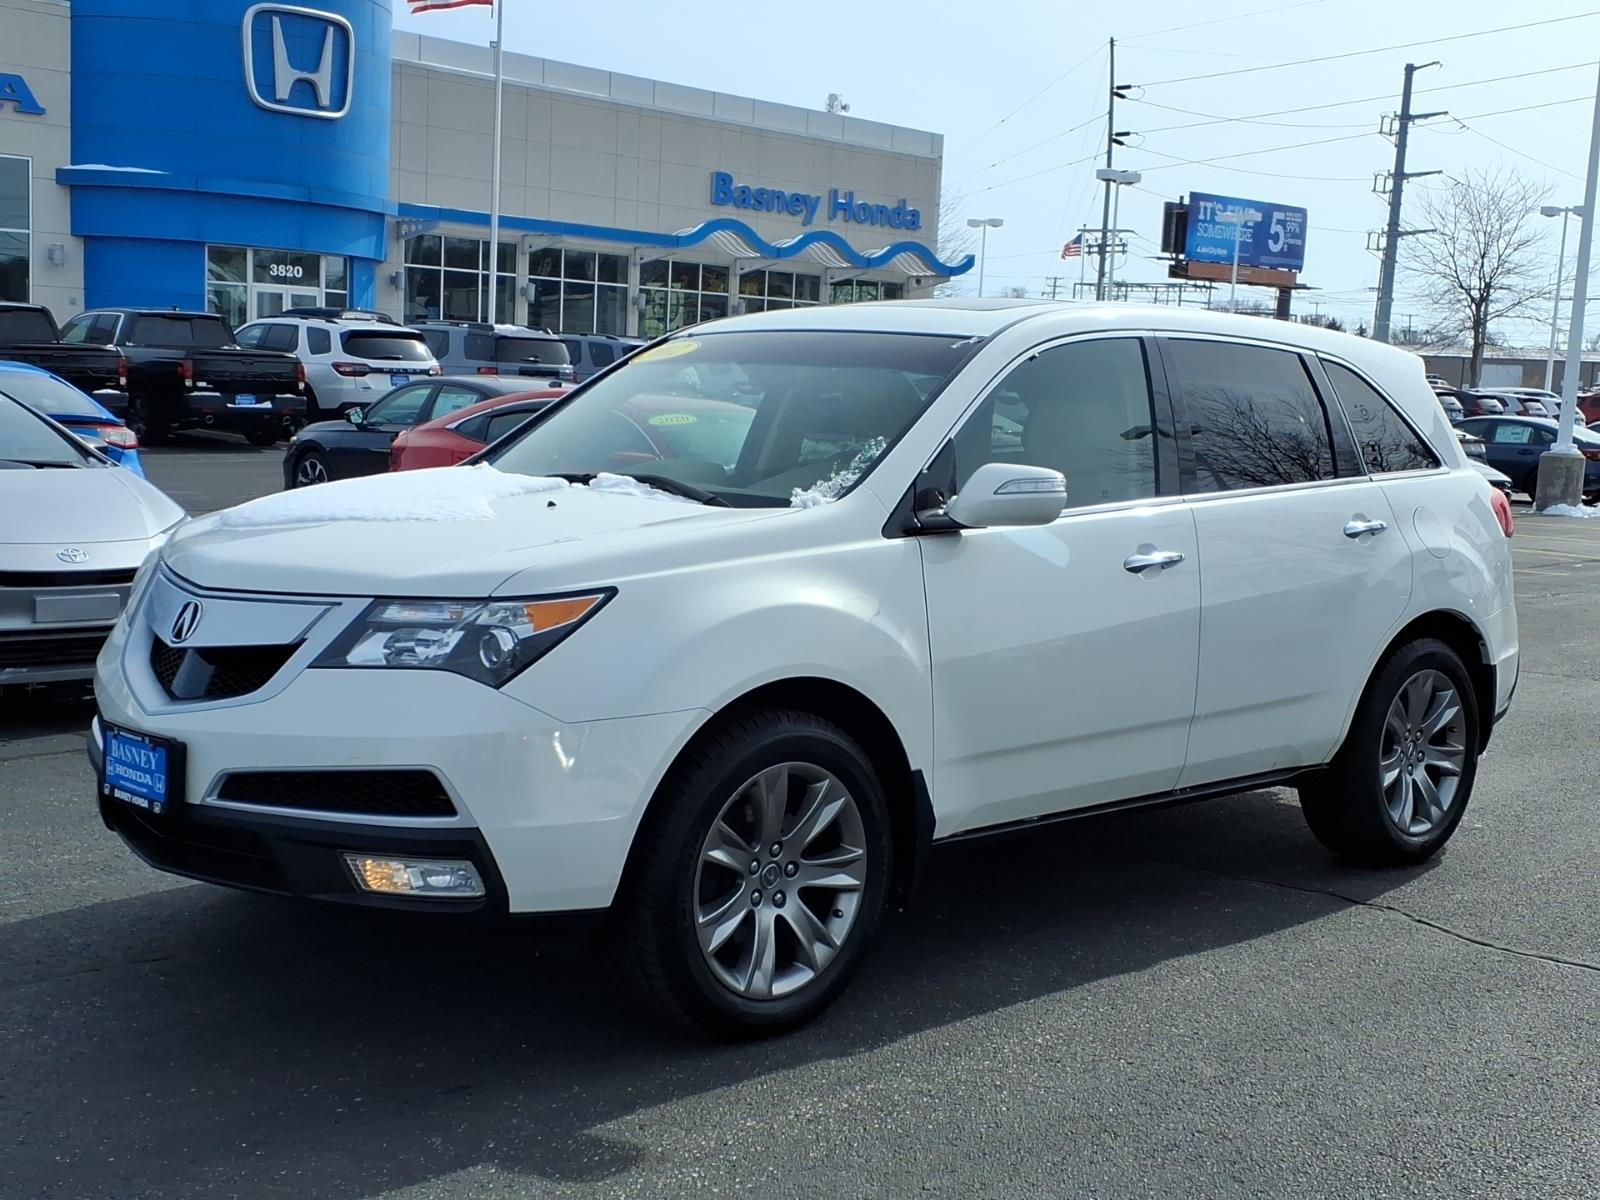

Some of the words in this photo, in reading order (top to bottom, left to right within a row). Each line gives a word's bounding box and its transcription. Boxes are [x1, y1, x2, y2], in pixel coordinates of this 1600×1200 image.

[711, 171, 821, 226] Basney
[828, 188, 921, 231] Honda
[1196, 222, 1253, 242] SOMEWHERE
[1268, 211, 1285, 253] 5
[270, 263, 303, 278] 3820
[112, 740, 158, 770] BASNEY
[115, 763, 153, 785] HONDA
